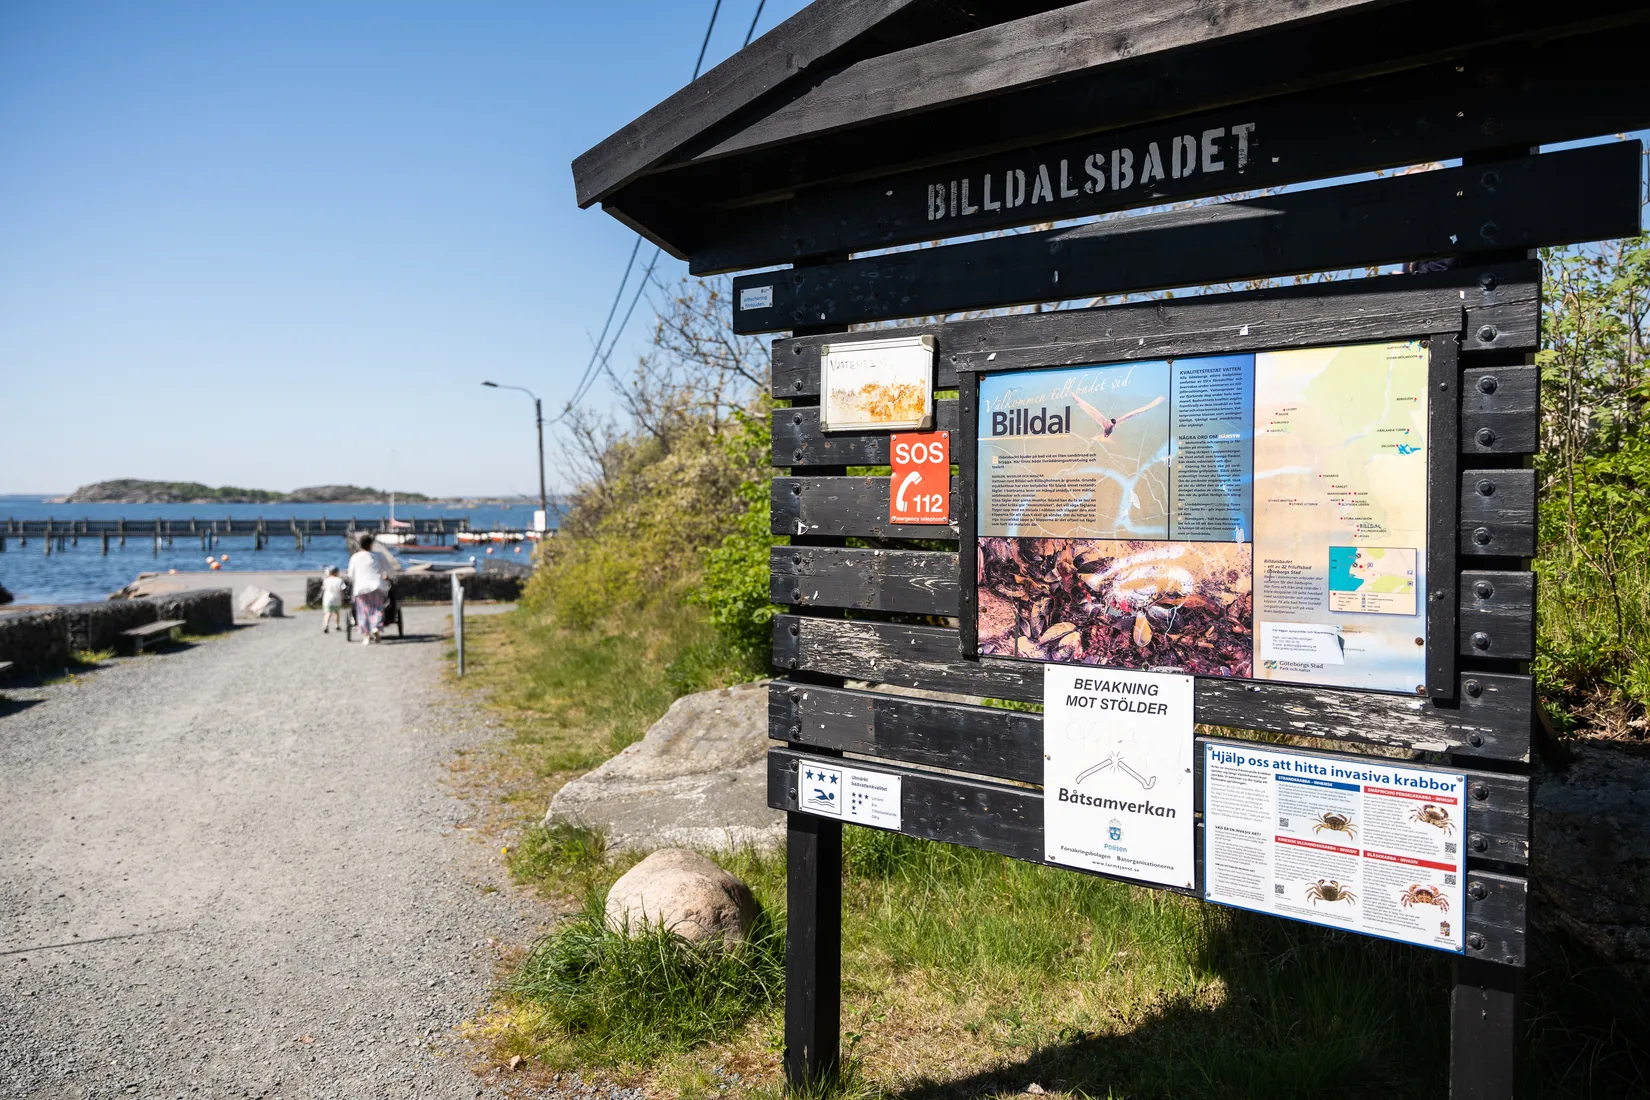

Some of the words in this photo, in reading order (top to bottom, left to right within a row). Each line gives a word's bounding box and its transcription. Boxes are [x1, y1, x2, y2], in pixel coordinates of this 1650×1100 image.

[927, 123, 1255, 220] BILLDALSBADET
[985, 389, 1046, 413] Välkommen
[1051, 377, 1076, 400] till
[1075, 372, 1106, 396] badet
[1111, 365, 1137, 389] vid
[992, 406, 1071, 436] Billdal
[895, 442, 944, 465] SOS
[913, 494, 943, 512] 112
[1280, 660, 1309, 668] Göteborgs
[1074, 678, 1159, 697] BEVAKNING
[1065, 694, 1097, 709] MOT
[1100, 698, 1168, 716] STÖLDER
[1211, 750, 1245, 766] Hjälp
[1248, 758, 1270, 768] oss
[1272, 760, 1291, 770] att
[1295, 761, 1327, 776] hitta
[1331, 766, 1389, 784] invasiva
[1394, 774, 1456, 792] krabbor
[1058, 788, 1176, 818] Båtsamverkan
[1104, 844, 1128, 852] Polisen
